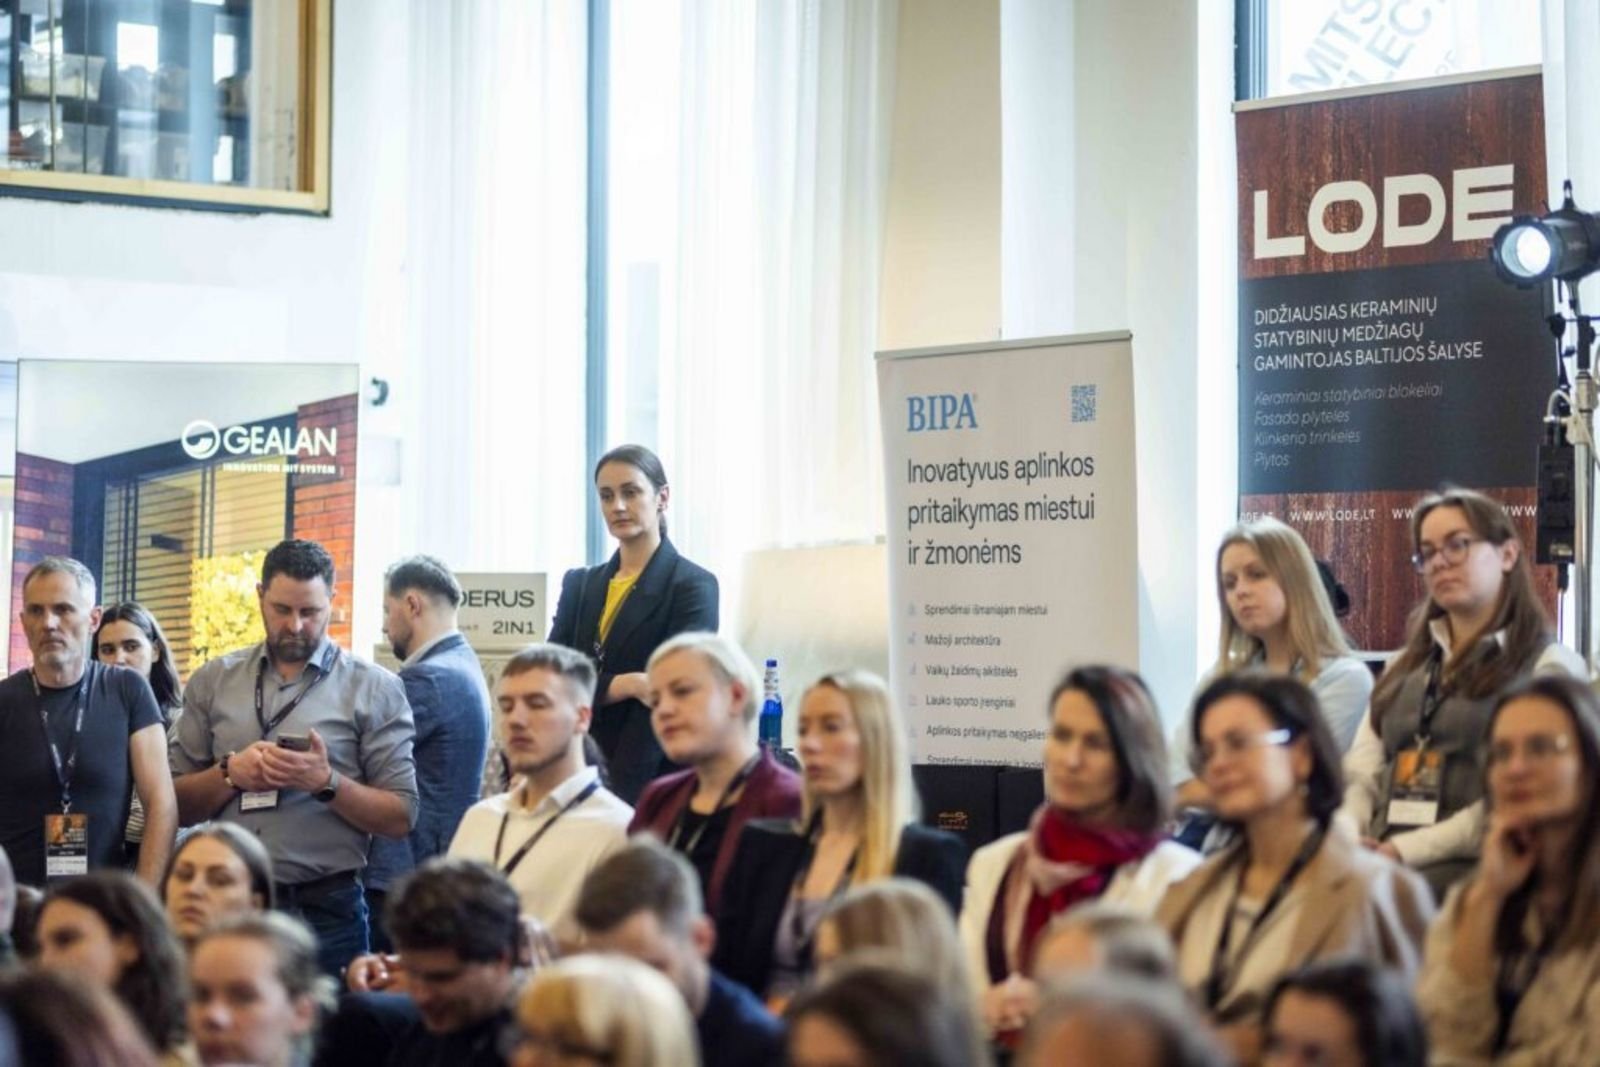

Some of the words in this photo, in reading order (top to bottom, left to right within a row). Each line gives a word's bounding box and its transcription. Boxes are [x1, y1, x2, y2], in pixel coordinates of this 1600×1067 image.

[1254, 164, 1514, 260] LODE
[1255, 304, 1347, 325] DIDŽIAUSIAS
[1351, 297, 1437, 317] KERAMINIŲ
[1255, 328, 1339, 348] STATYBINIŲ
[1343, 320, 1424, 342] MEDŽIAGŲ
[1255, 352, 1352, 371] GAMINTOJAS
[1356, 345, 1425, 366] BALTIJOS
[1428, 340, 1483, 360] ŠALYSE
[907, 393, 978, 432] BIPA
[223, 426, 337, 456] GEALAN
[908, 457, 1009, 488] Inovatyvus
[1014, 451, 1094, 485] aplinkos
[908, 497, 1019, 531] pritaikymas
[1025, 493, 1095, 520] miestui
[908, 539, 920, 565] ir
[925, 538, 1021, 565] žmonėms
[1018, 604, 1048, 616] miestui
[493, 621, 535, 635] 2IN1
[953, 696, 979, 707] sporto
[926, 725, 961, 738] Aplinkos
